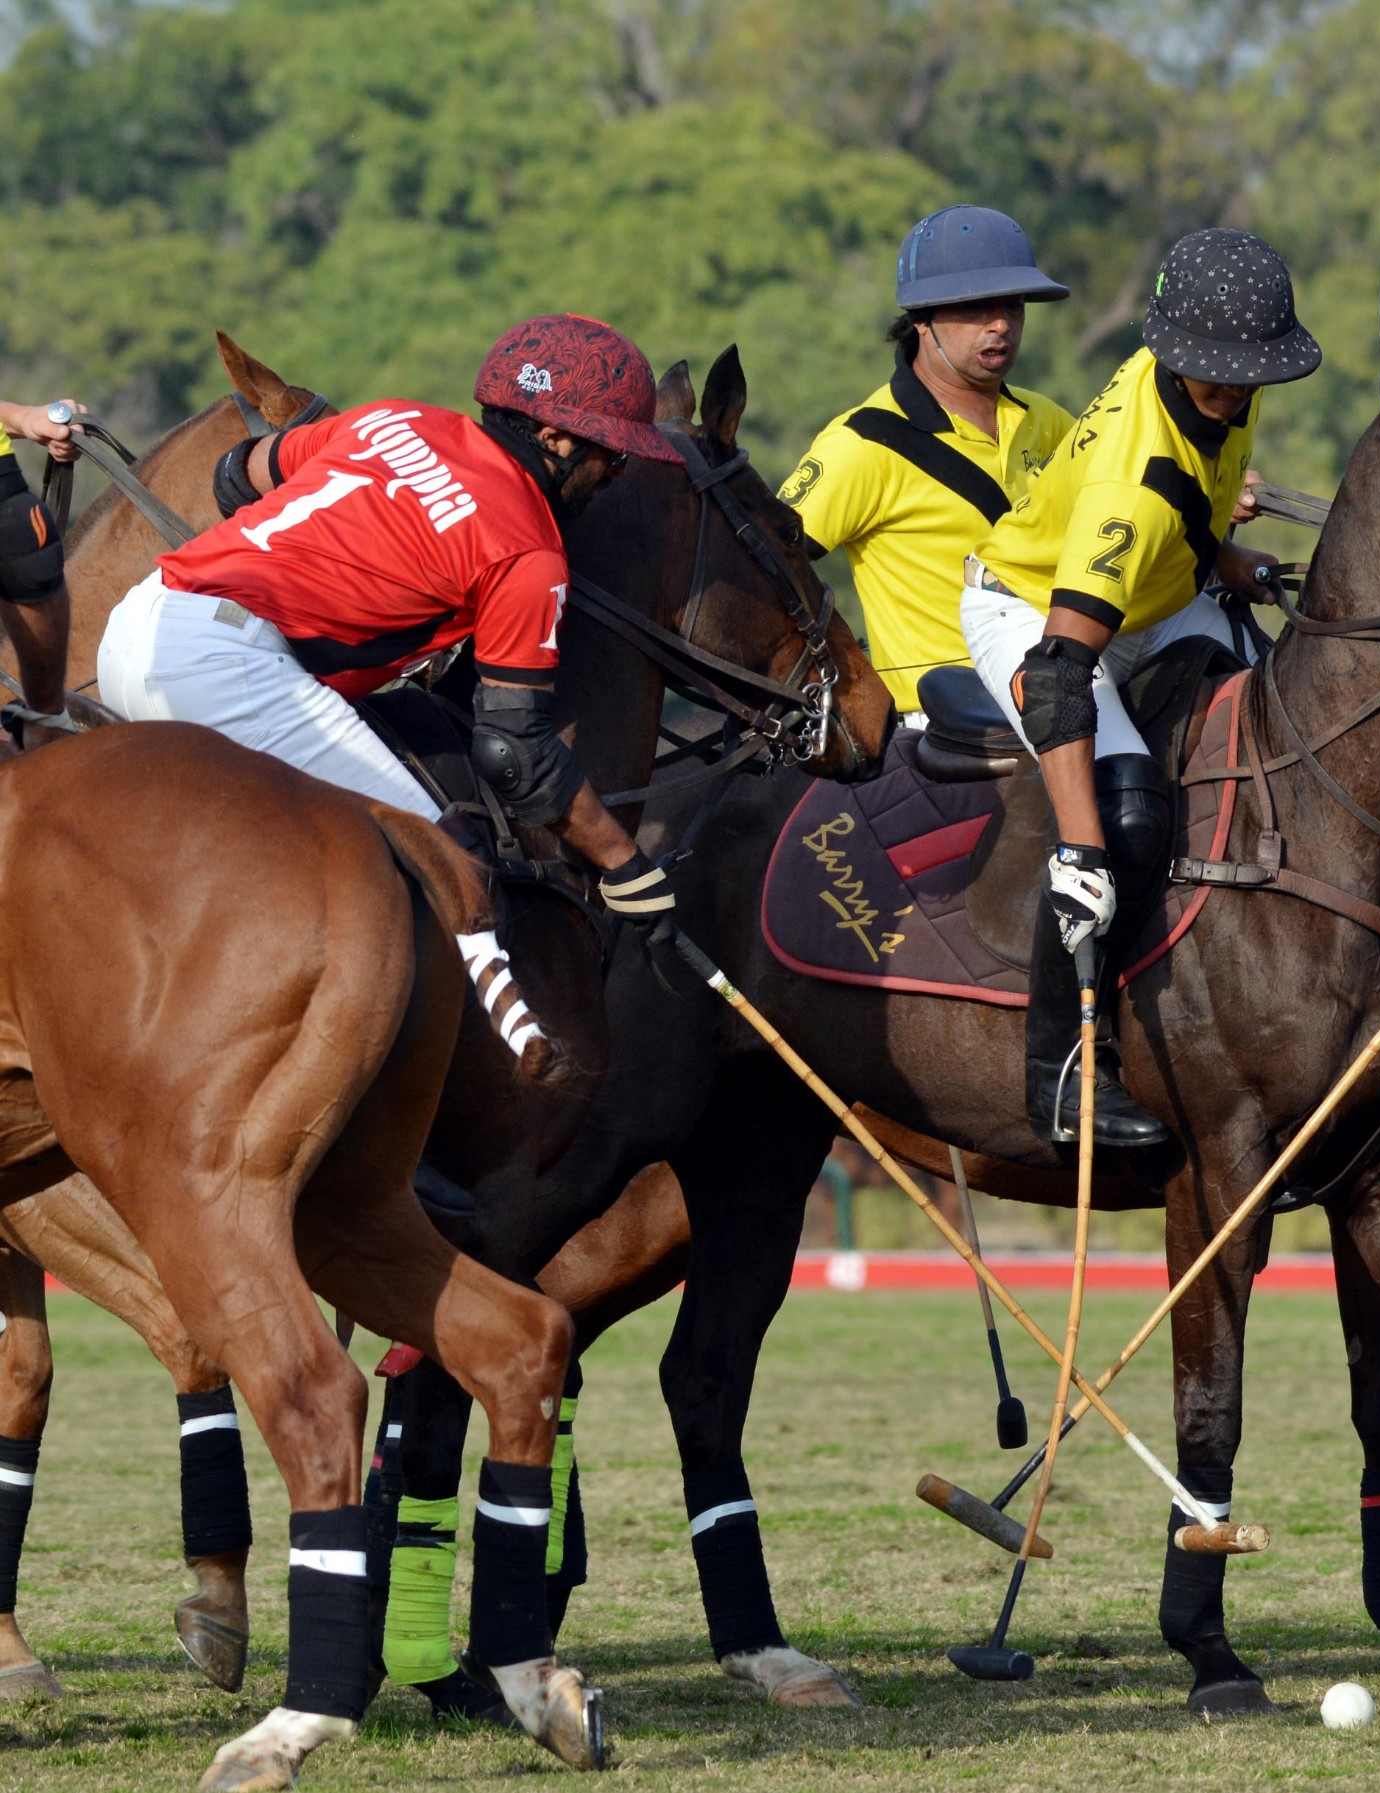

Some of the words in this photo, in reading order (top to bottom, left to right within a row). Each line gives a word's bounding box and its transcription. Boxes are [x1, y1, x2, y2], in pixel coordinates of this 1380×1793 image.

[240, 470, 373, 551] 1
[777, 456, 823, 508] 3
[1086, 517, 1138, 584] 2
[539, 583, 567, 649] 1
[802, 813, 914, 963] Barry's
